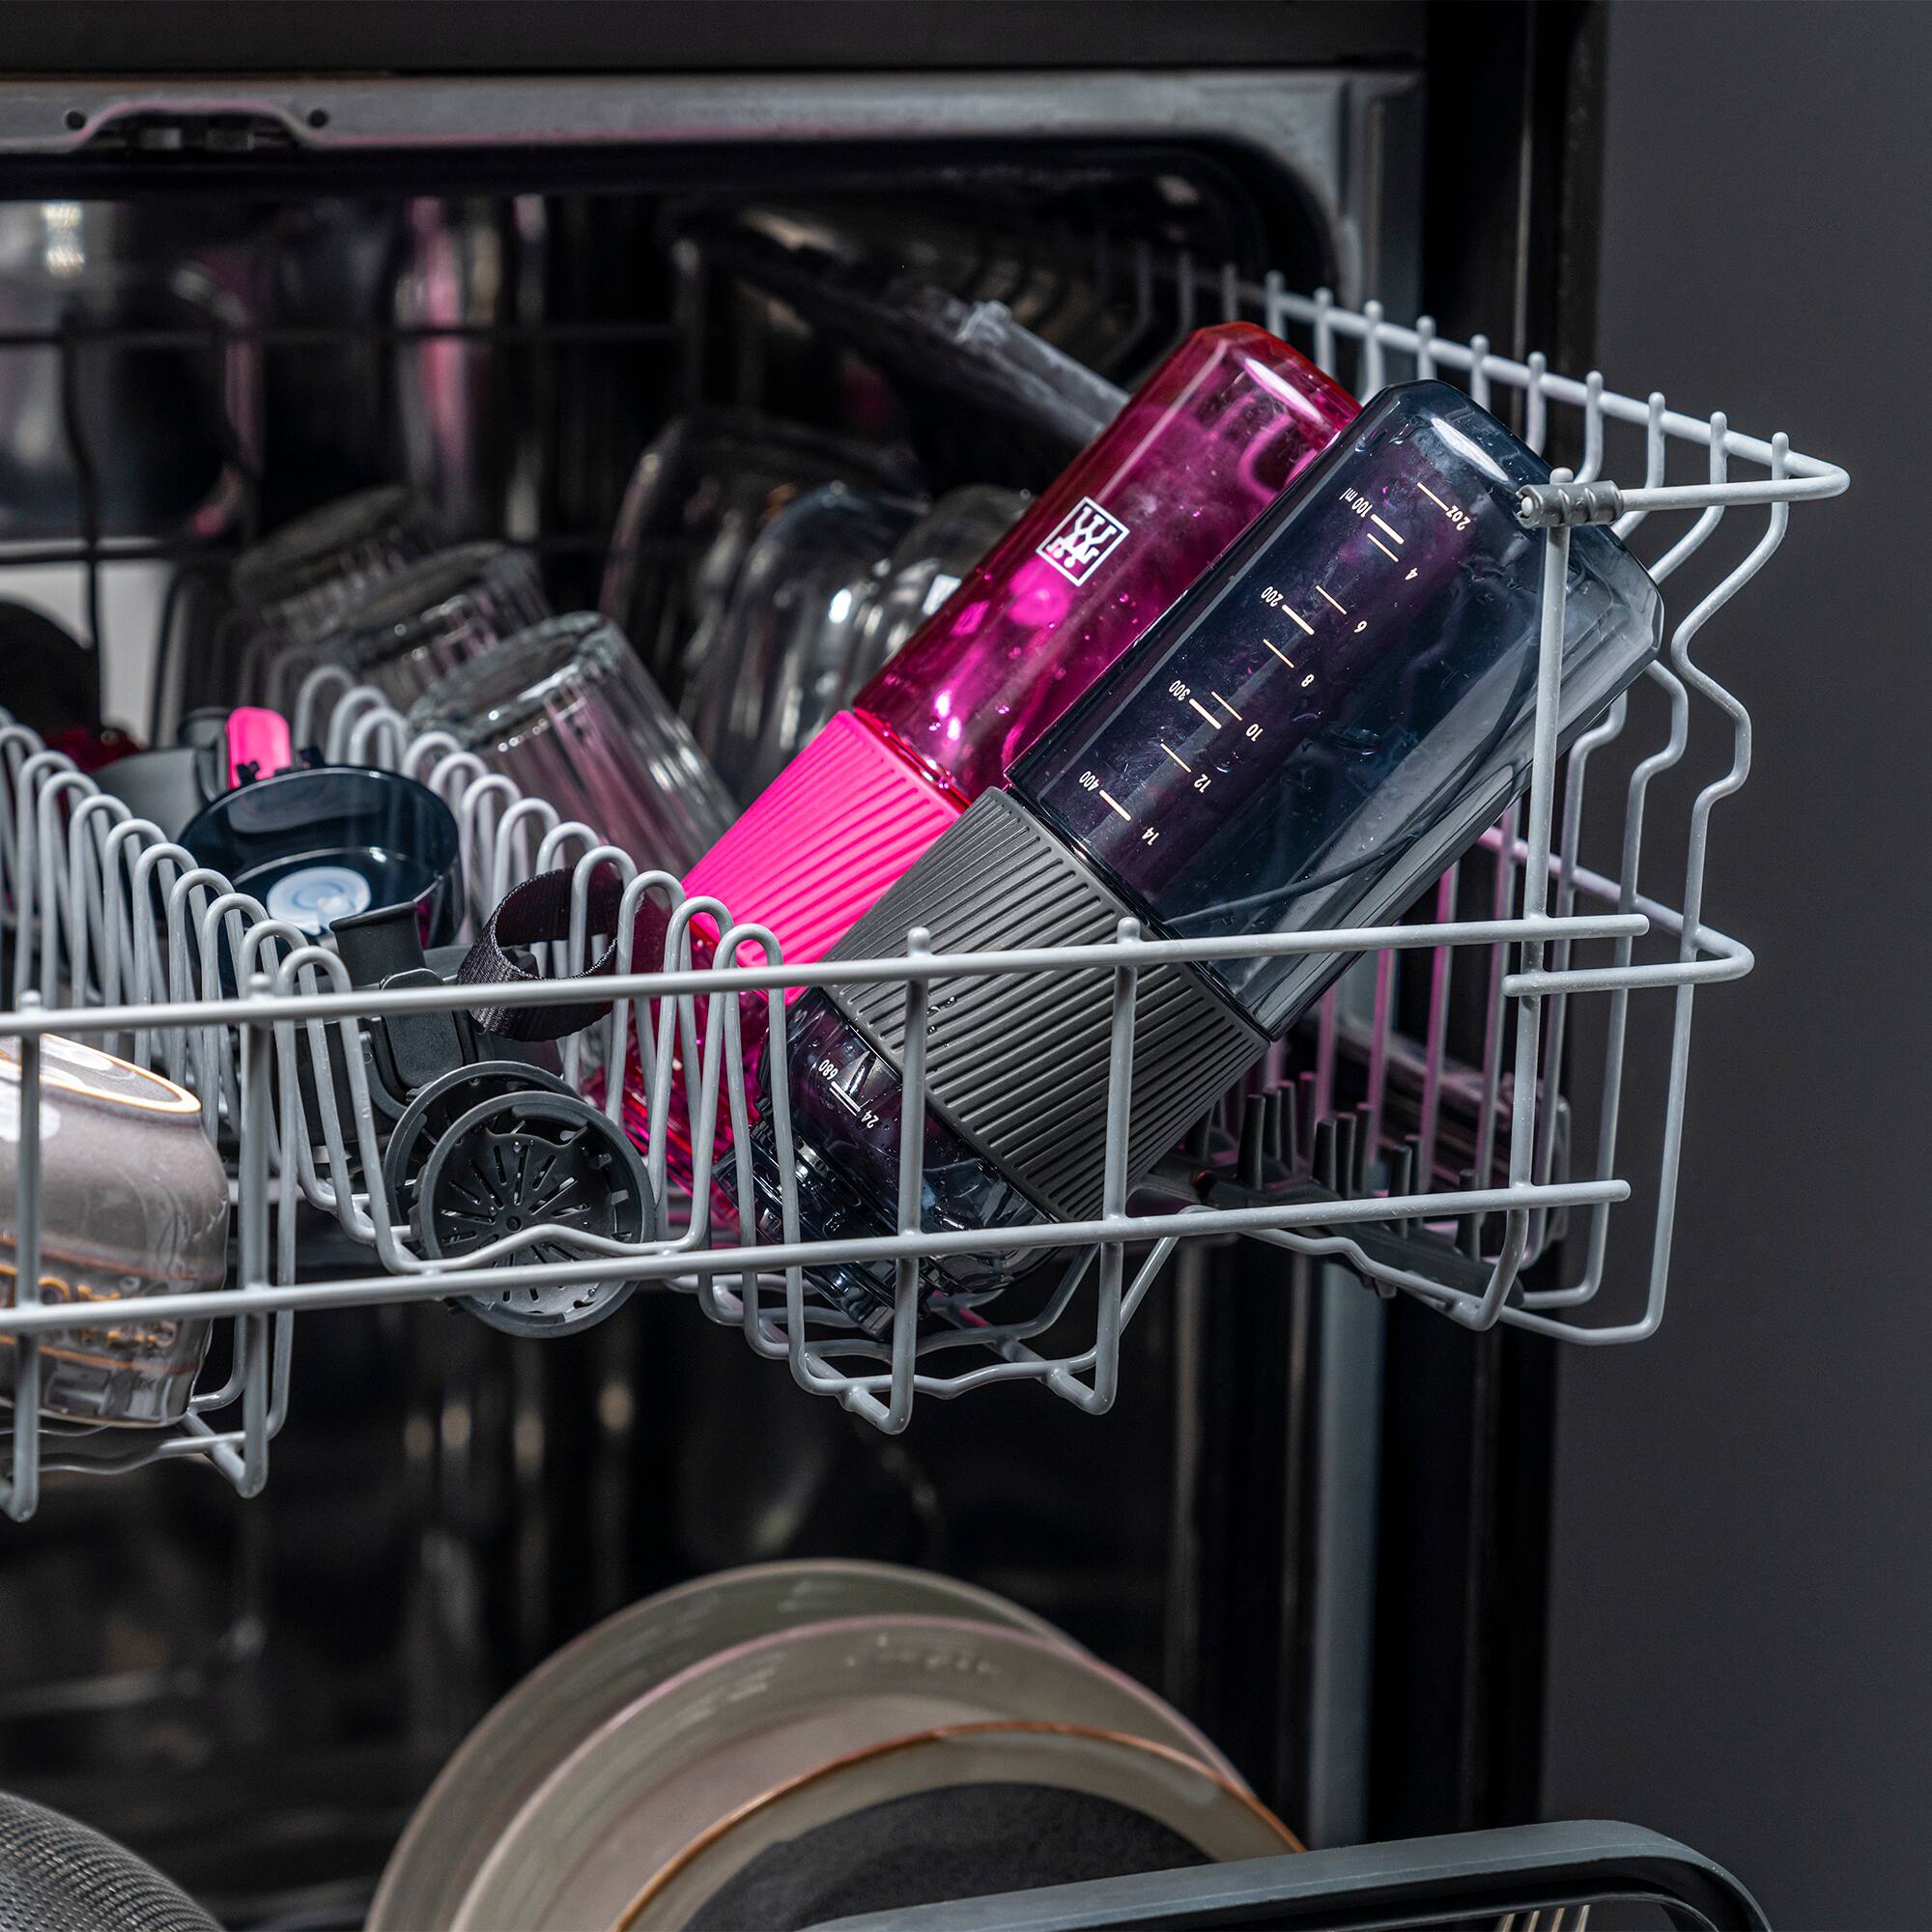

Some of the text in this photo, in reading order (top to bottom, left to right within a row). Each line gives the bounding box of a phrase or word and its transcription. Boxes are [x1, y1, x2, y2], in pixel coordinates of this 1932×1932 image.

[1339, 487, 1374, 519] 100 ml
[1405, 567, 1418, 581] 4
[1261, 585, 1284, 608] 200
[1353, 620, 1368, 634] 6
[1168, 679, 1191, 701] 300
[1300, 673, 1315, 688] 8
[1245, 723, 1264, 742] 10
[1078, 770, 1099, 792] 400
[1193, 773, 1211, 793] 12
[1141, 826, 1160, 846] 14
[818, 1059, 839, 1081] 680
[861, 1109, 880, 1129] 24
